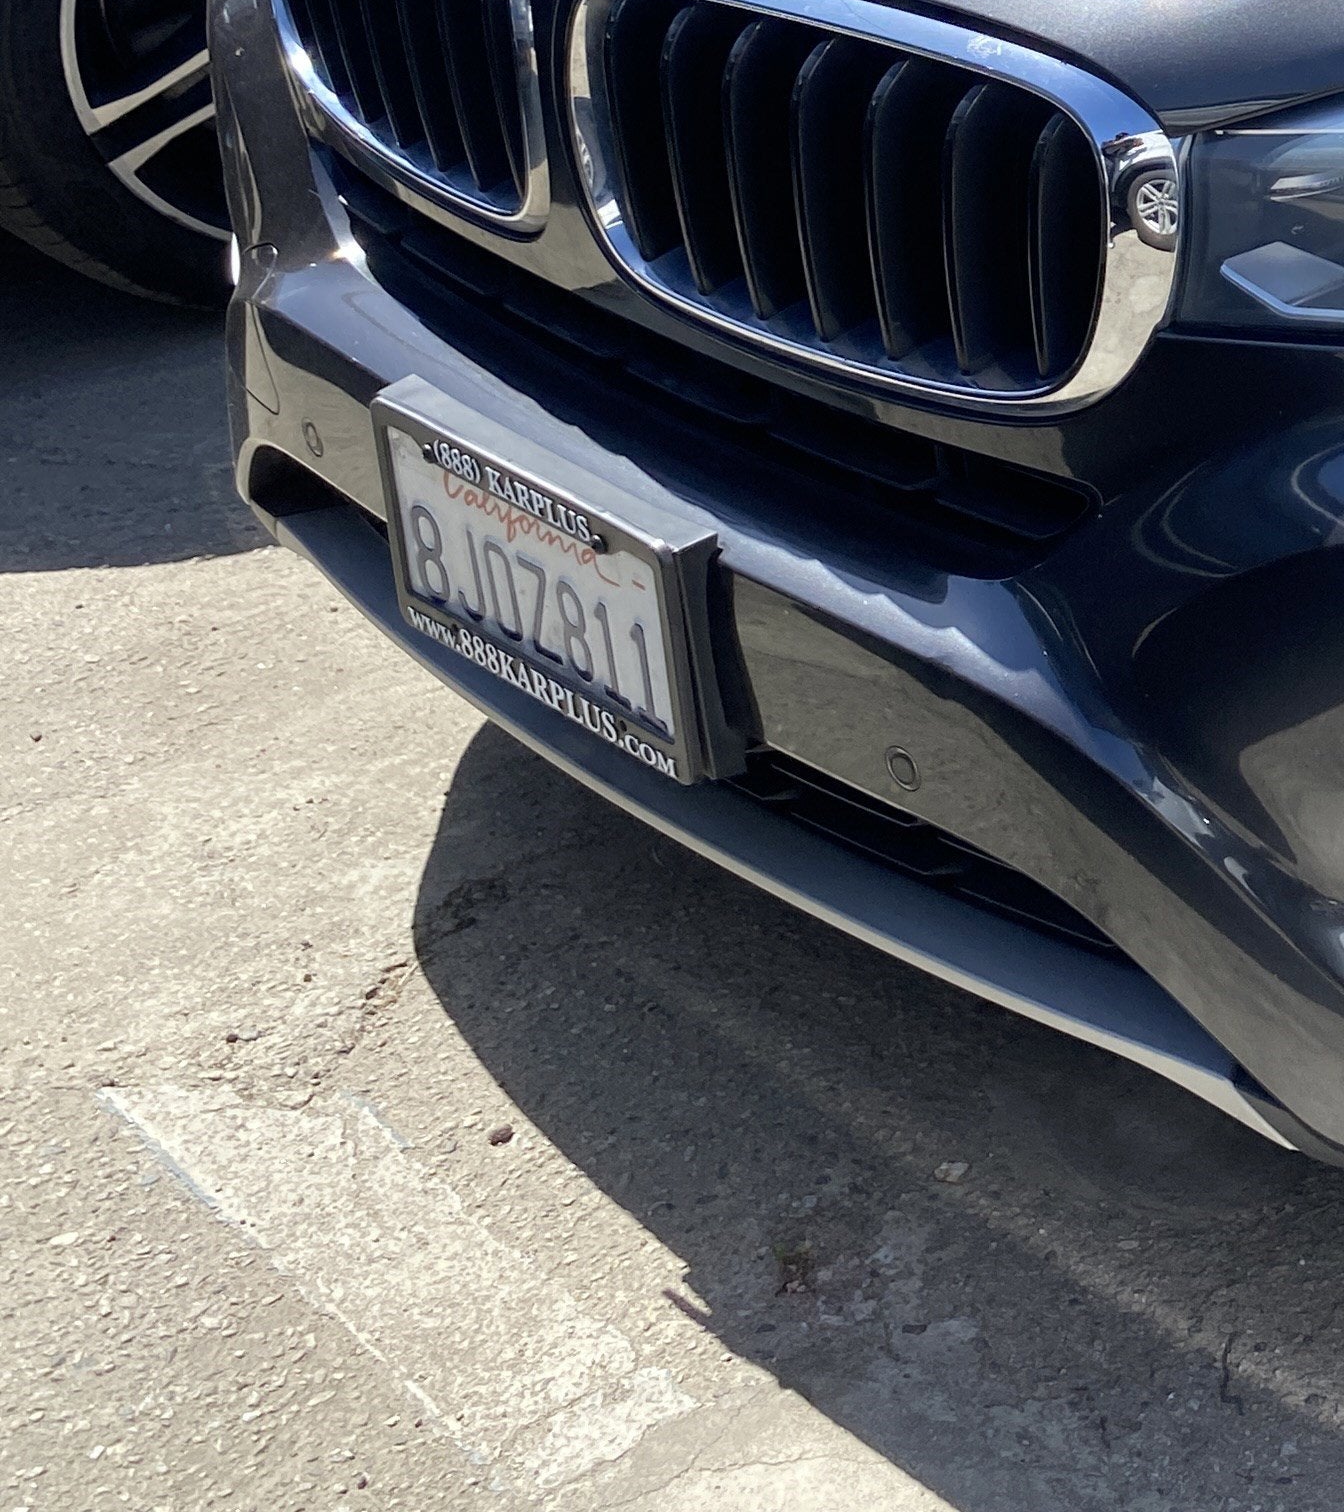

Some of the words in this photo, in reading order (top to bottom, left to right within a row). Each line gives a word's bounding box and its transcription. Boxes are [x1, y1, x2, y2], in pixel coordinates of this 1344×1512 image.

[433, 439, 482, 484] (888)
[485, 466, 592, 543] KARPLUS
[443, 472, 620, 587] California
